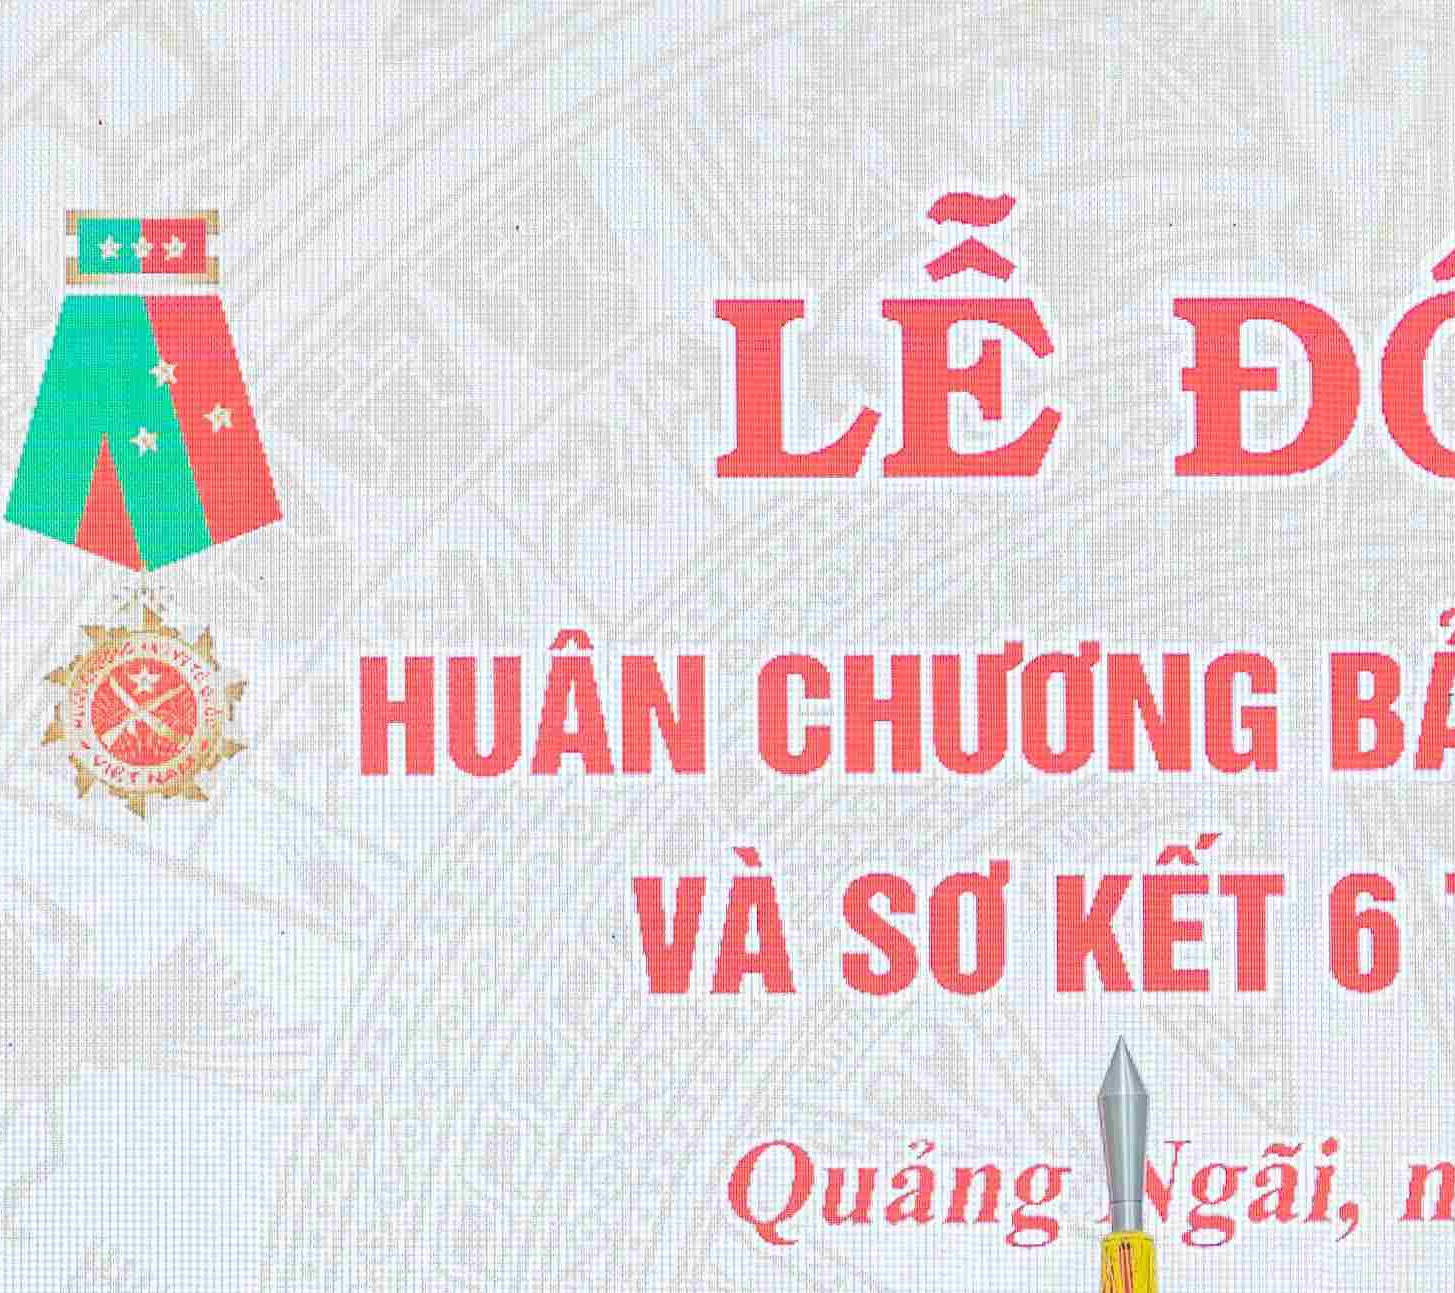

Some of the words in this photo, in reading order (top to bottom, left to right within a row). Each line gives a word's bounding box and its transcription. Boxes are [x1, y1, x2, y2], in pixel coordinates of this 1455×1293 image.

[713, 190, 1063, 479] LỄ
[358, 627, 708, 780] HUÂN
[756, 639, 1279, 776] CHƯƠNG
[632, 846, 797, 995] VÀ
[841, 858, 1012, 998] SƠ
[1055, 831, 1286, 994] KẾT
[1328, 872, 1401, 994] 6
[726, 1136, 1072, 1247] Quảng
[1096, 1136, 1361, 1246] Ngãi,
